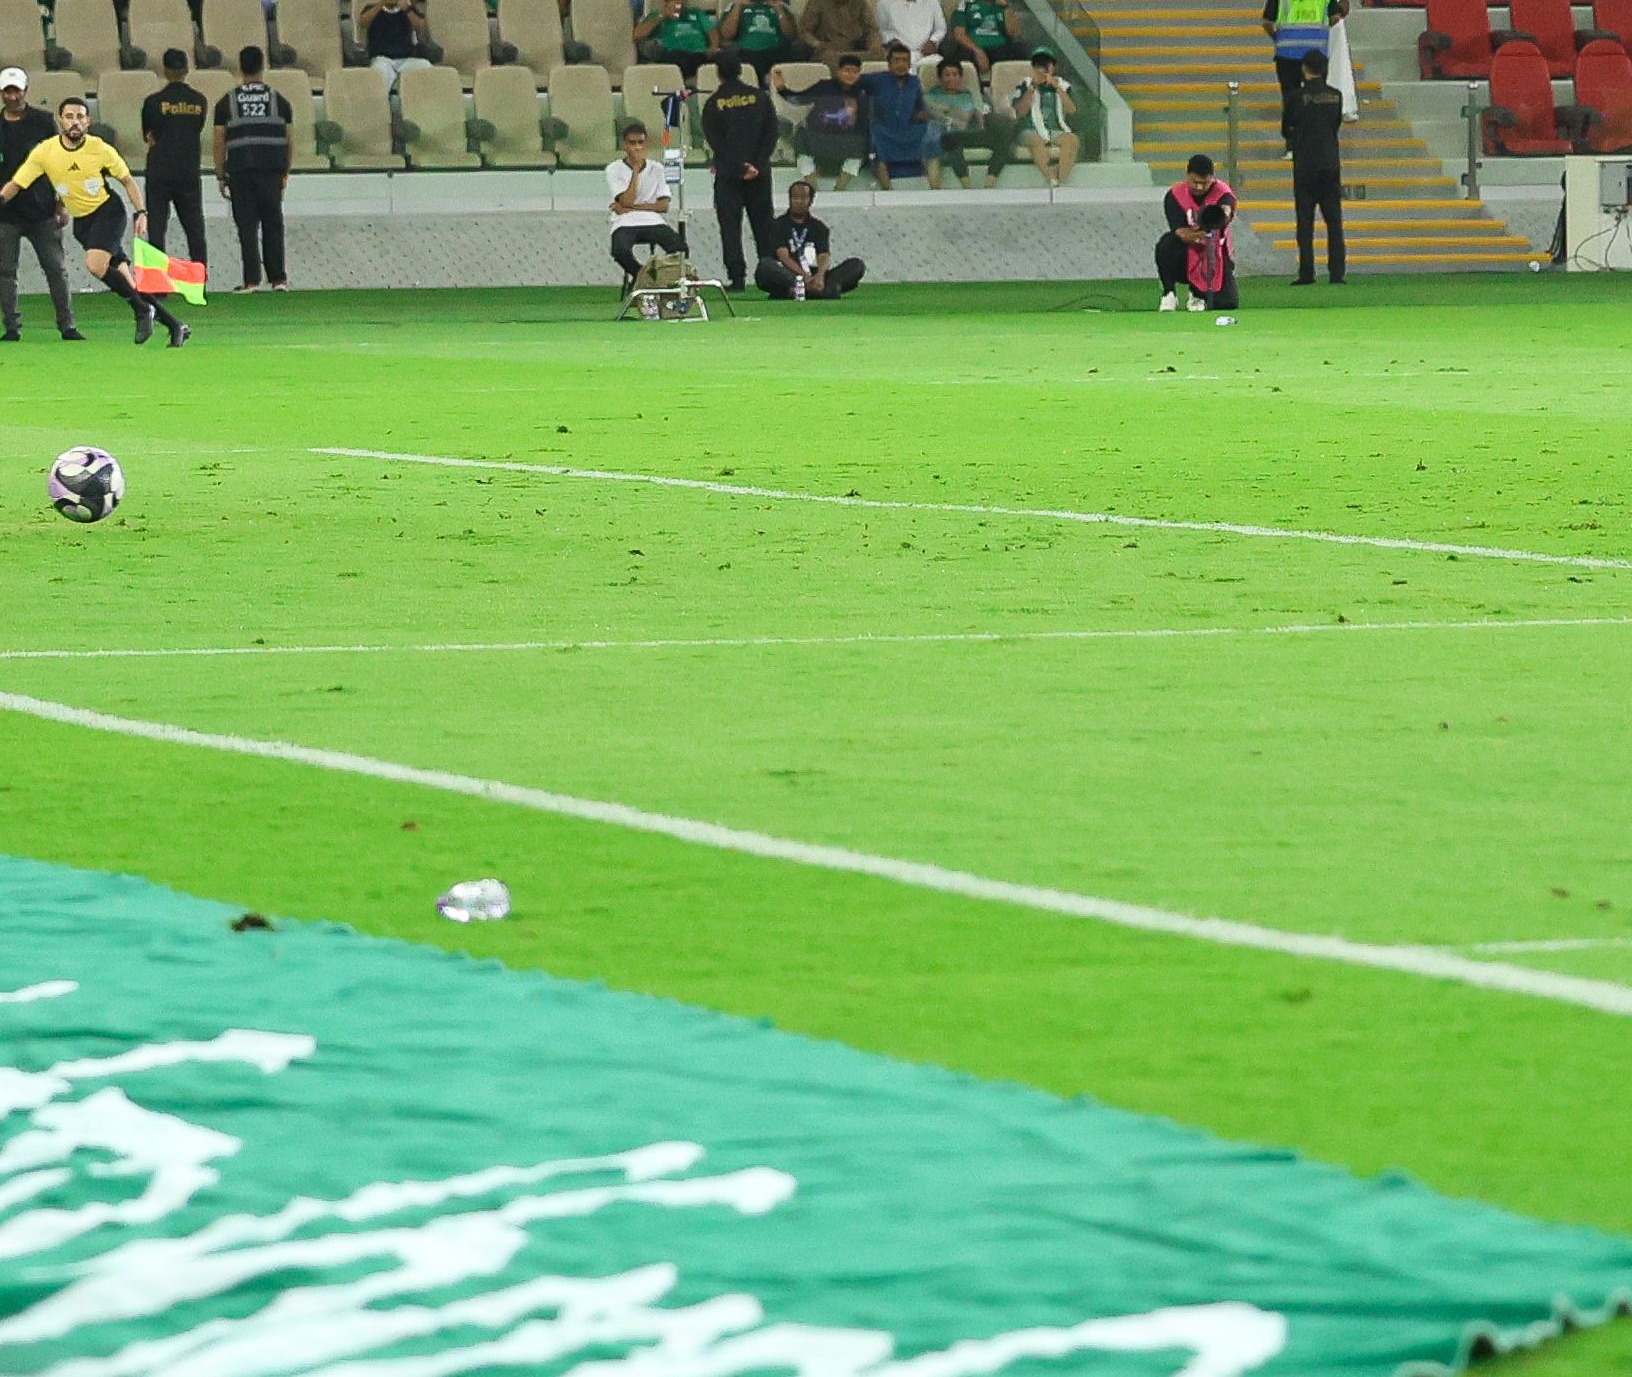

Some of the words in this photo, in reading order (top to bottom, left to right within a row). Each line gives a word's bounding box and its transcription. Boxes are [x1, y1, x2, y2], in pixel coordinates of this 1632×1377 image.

[238, 91, 269, 103] Guard
[717, 94, 757, 111] Police
[161, 102, 202, 116] Police
[242, 103, 266, 116] 522
